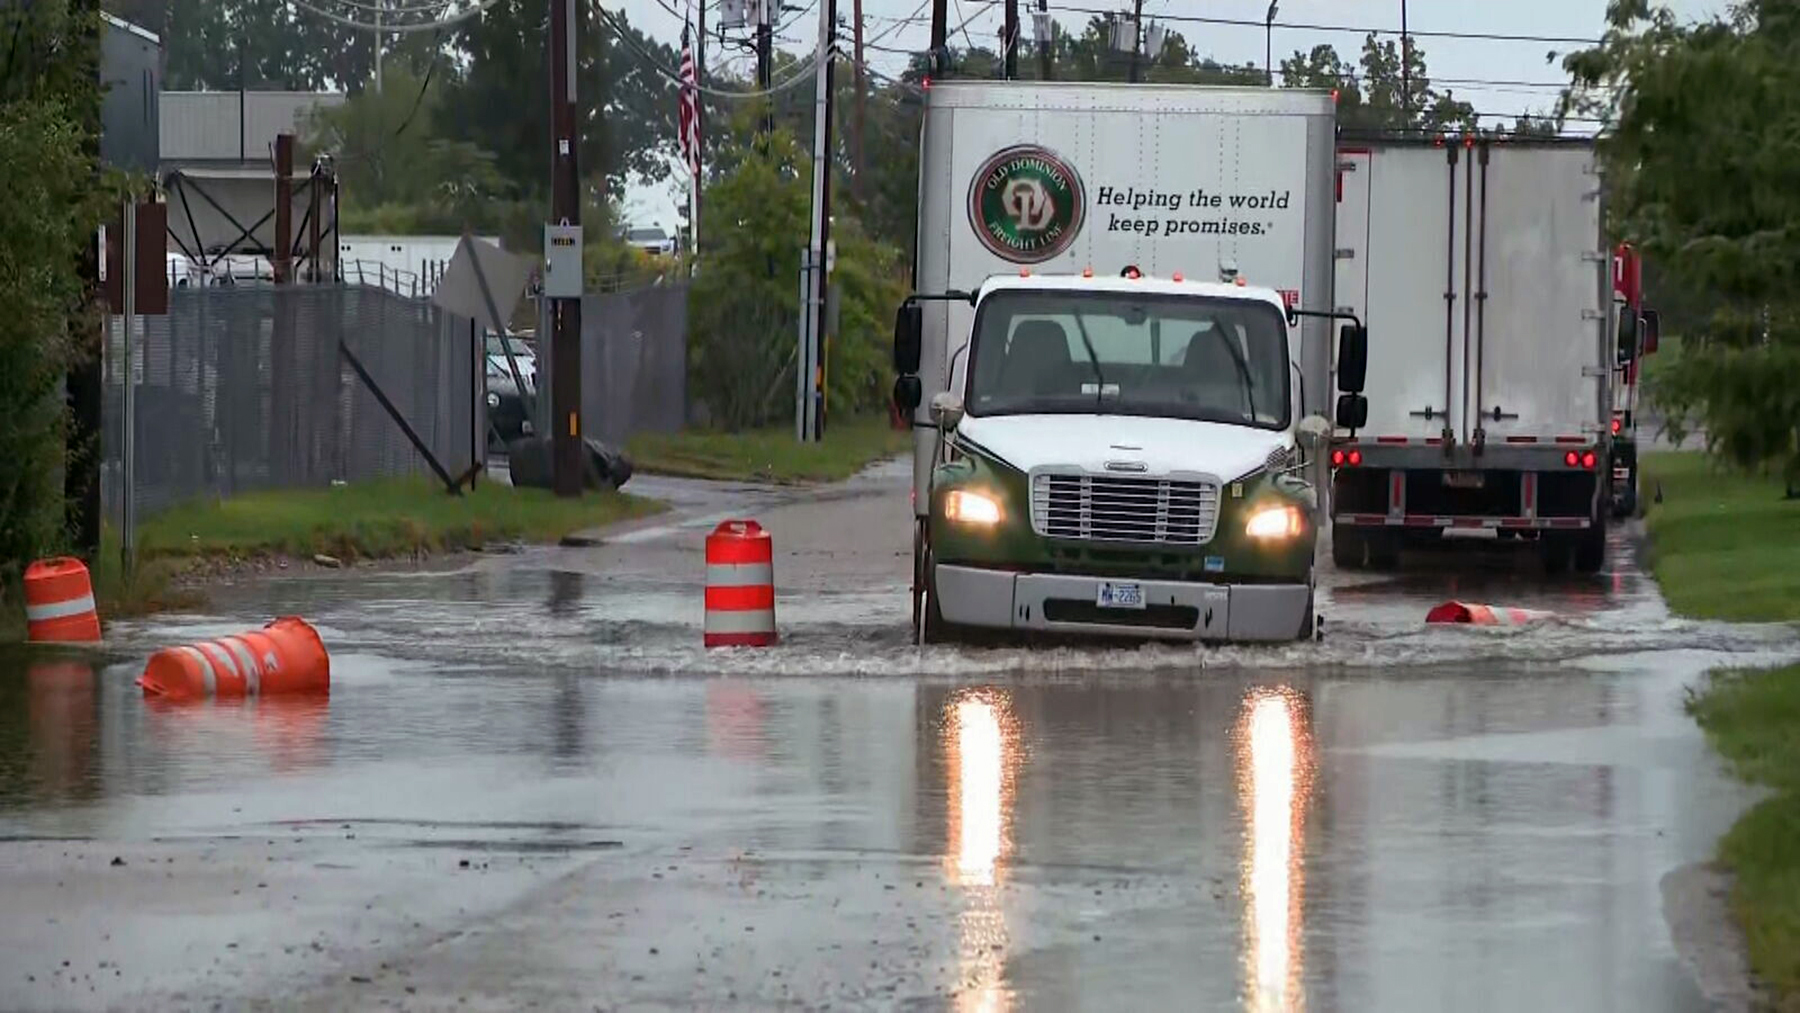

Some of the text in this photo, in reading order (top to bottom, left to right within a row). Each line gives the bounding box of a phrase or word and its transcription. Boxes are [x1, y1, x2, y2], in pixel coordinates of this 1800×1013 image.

[987, 159, 1067, 191] OLD DOMINION
[1096, 186, 1290, 211] Helping the world
[989, 221, 1063, 250] FREIGHT LINE
[1107, 213, 1159, 237] keep
